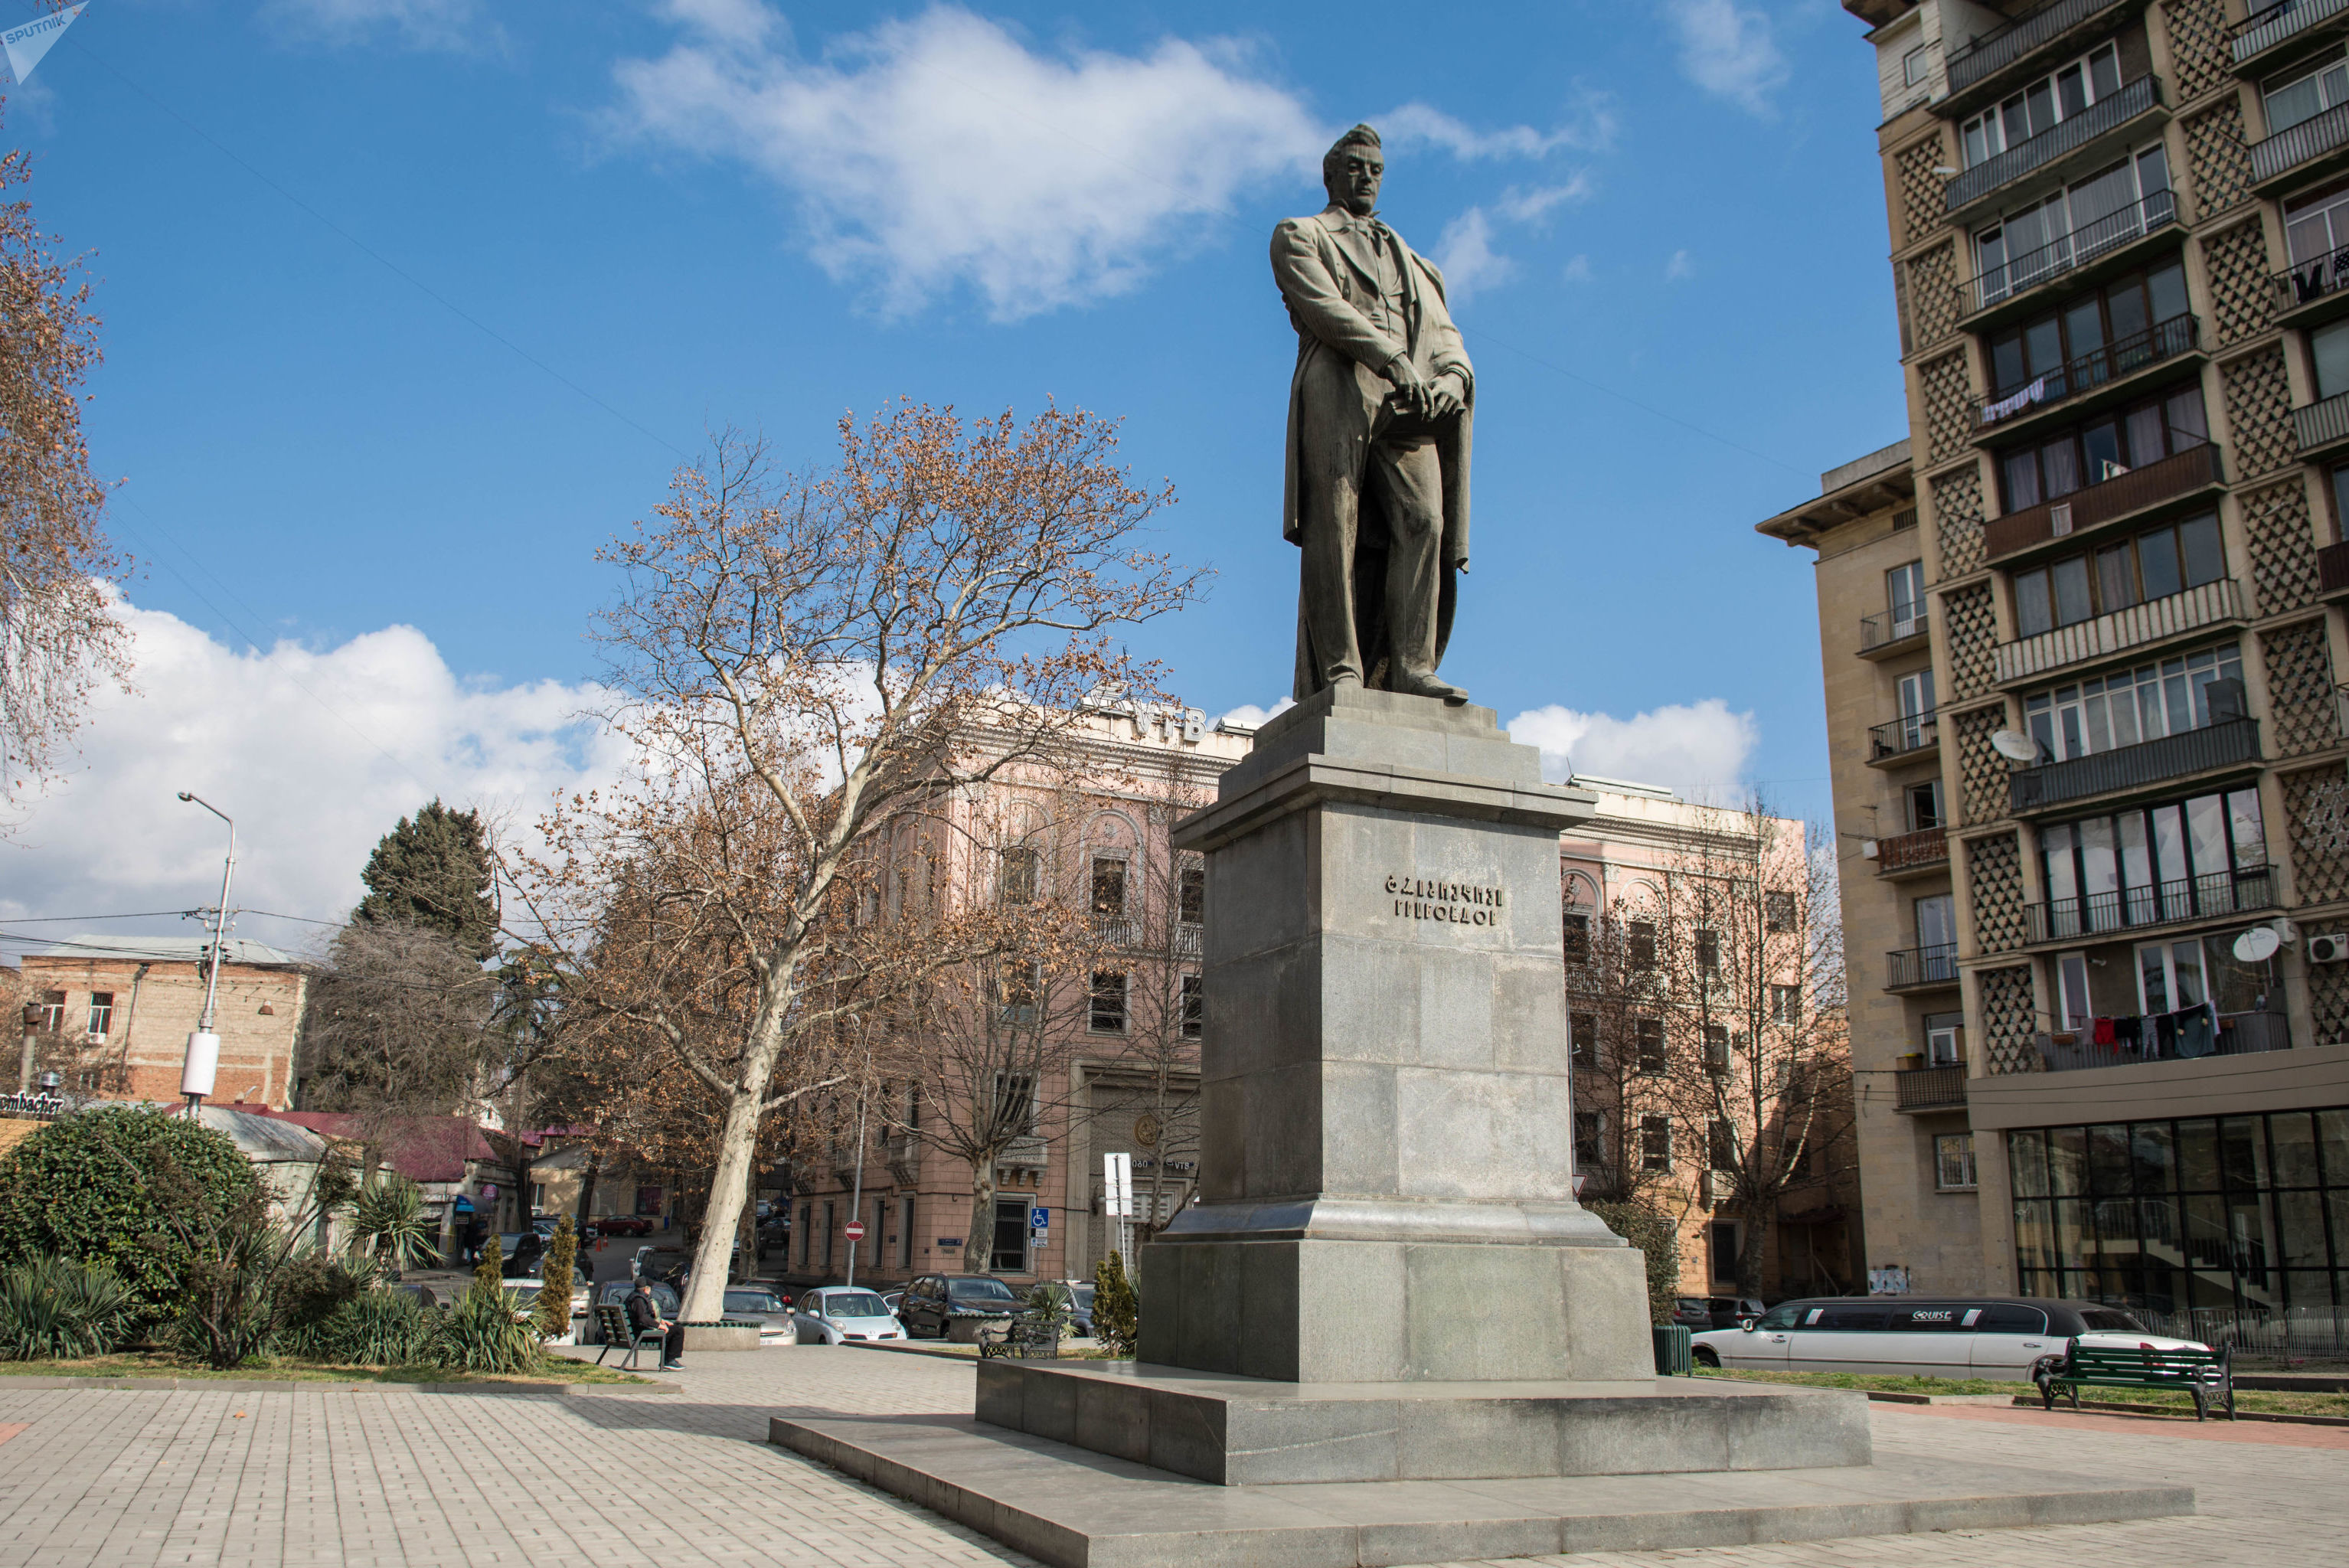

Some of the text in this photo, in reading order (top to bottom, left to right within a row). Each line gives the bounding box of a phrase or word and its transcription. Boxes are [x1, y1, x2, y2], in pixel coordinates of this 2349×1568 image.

[1133, 697, 1207, 742] VTB
[0, 1091, 64, 1114] ombacher
[1175, 1161, 1190, 1170] VTB
[1912, 1310, 1952, 1321] CRUISE
